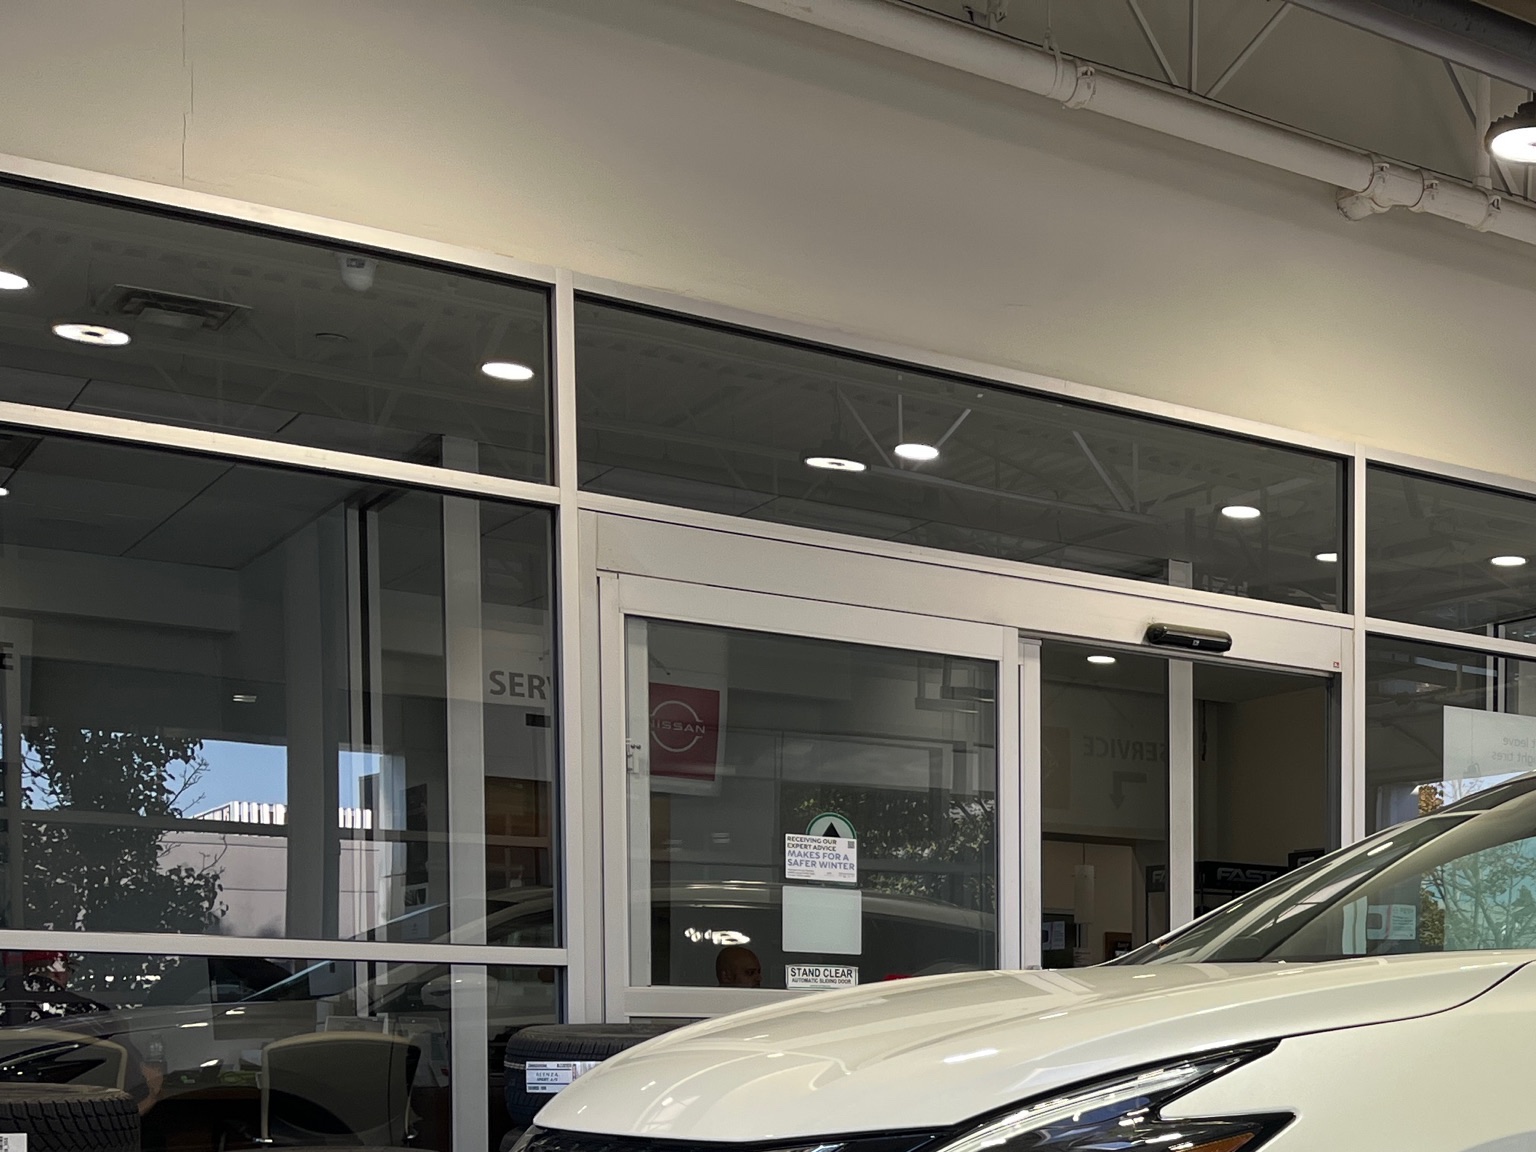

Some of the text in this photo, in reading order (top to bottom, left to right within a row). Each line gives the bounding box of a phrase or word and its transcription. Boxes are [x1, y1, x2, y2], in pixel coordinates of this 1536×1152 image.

[489, 670, 551, 700] SER
[787, 836, 822, 844] RECEIVING
[787, 842, 837, 852] EXPERT ADVICE
[787, 850, 820, 860] MAKES
[822, 852, 841, 861] FOR
[787, 859, 855, 871] SAFER WINTER
[790, 967, 853, 979] STAND CLEAR
